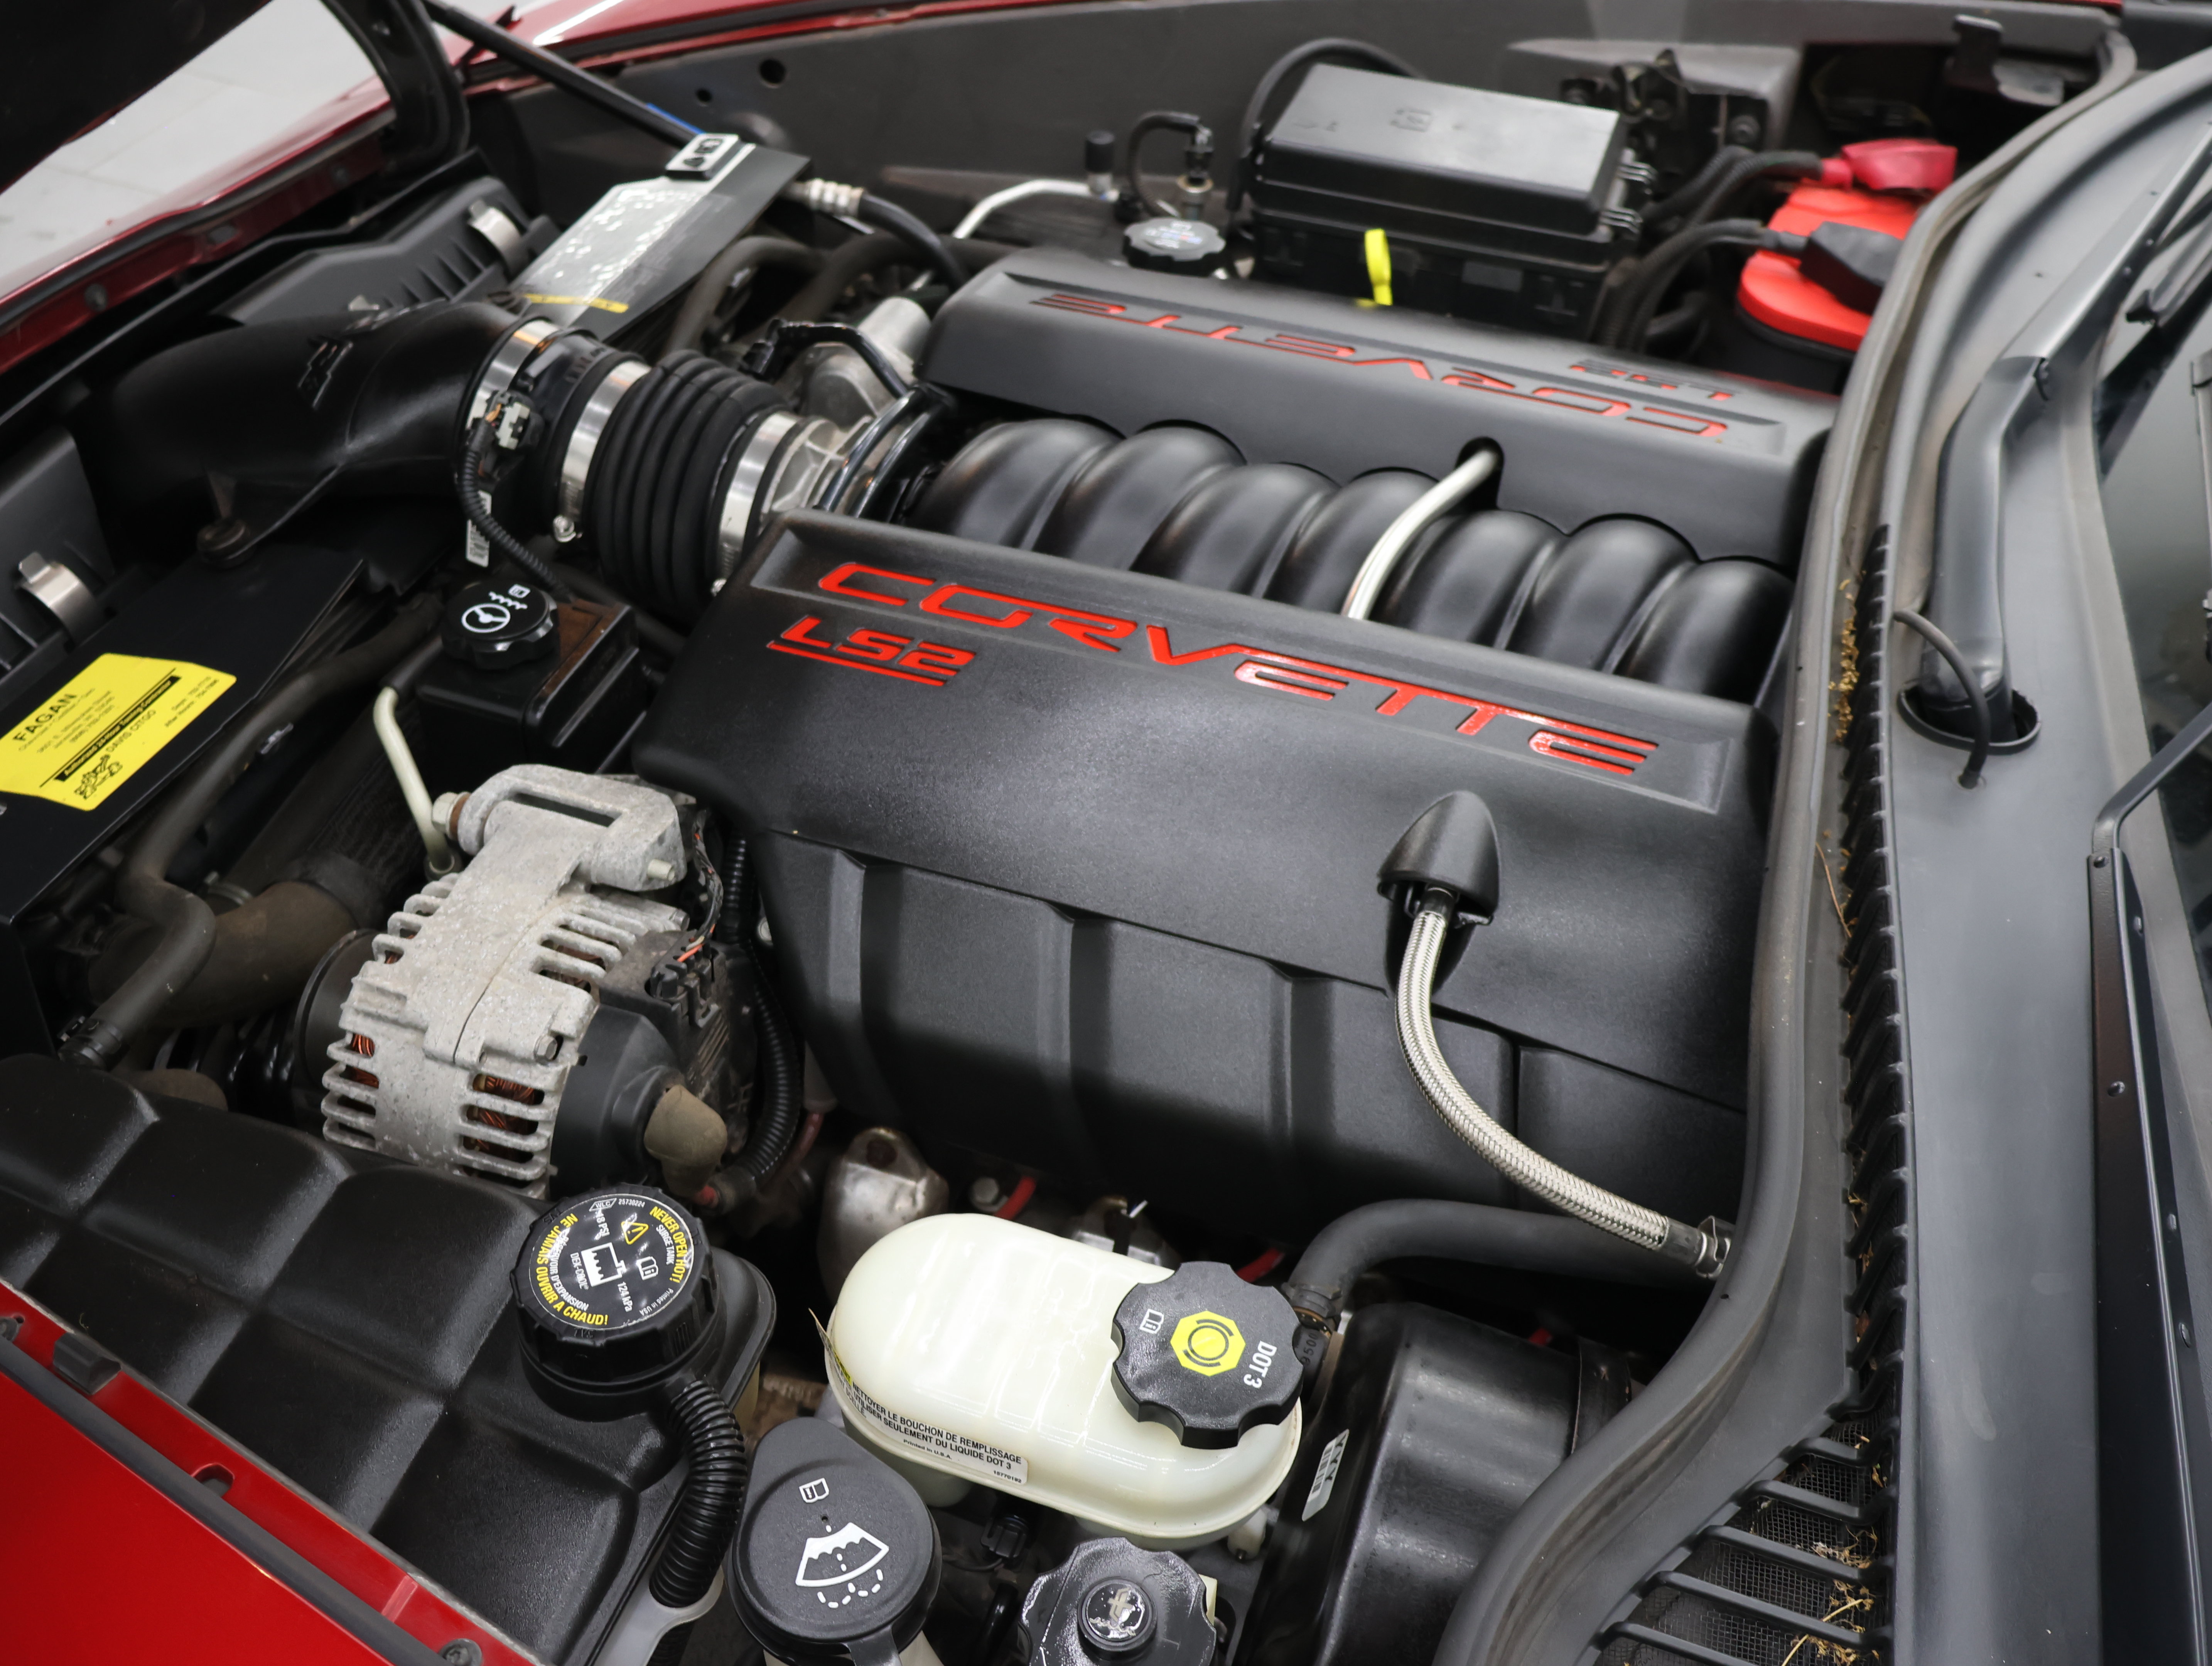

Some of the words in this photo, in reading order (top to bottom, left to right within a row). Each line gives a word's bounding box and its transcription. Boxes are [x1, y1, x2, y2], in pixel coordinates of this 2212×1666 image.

[1029, 294, 1728, 437] CORVETTE
[780, 615, 977, 677] LS2
[818, 562, 1659, 776] CORVETTE
[13, 693, 77, 741] FAGAN
[618, 1198, 645, 1208] 25730224
[560, 1213, 578, 1228] NE
[599, 1223, 610, 1237] PSI
[649, 1206, 680, 1233] NEVER
[537, 1225, 561, 1265] JAMAIS
[656, 1224, 673, 1247] SURGE
[666, 1245, 675, 1265] TANK
[672, 1231, 688, 1258] OPEN
[669, 1259, 686, 1283] HOT!
[536, 1266, 559, 1304] OUVRIR
[550, 1274, 589, 1312] D'EXPANSION
[618, 1282, 629, 1297] 124
[656, 1288, 674, 1305] Printed
[553, 1301, 565, 1312] A
[563, 1306, 609, 1325] CHAUD!
[622, 1295, 633, 1312] kPa
[639, 1305, 653, 1316] USA
[1249, 1340, 1277, 1378] DOT
[1243, 1373, 1262, 1389] 3
[853, 1381, 886, 1416] NETTOYER
[888, 1410, 898, 1422] LE
[900, 1416, 943, 1438] BOUCHON
[946, 1432, 958, 1443] DE
[960, 1437, 1022, 1464] REMPLISSAGE
[854, 1391, 882, 1421] UTILISER
[883, 1416, 933, 1443] SEULEMENT
[935, 1438, 948, 1448] DU
[950, 1443, 984, 1460] LIQUIDE
[986, 1455, 1004, 1467] DOT
[903, 1439, 926, 1450] Printed
